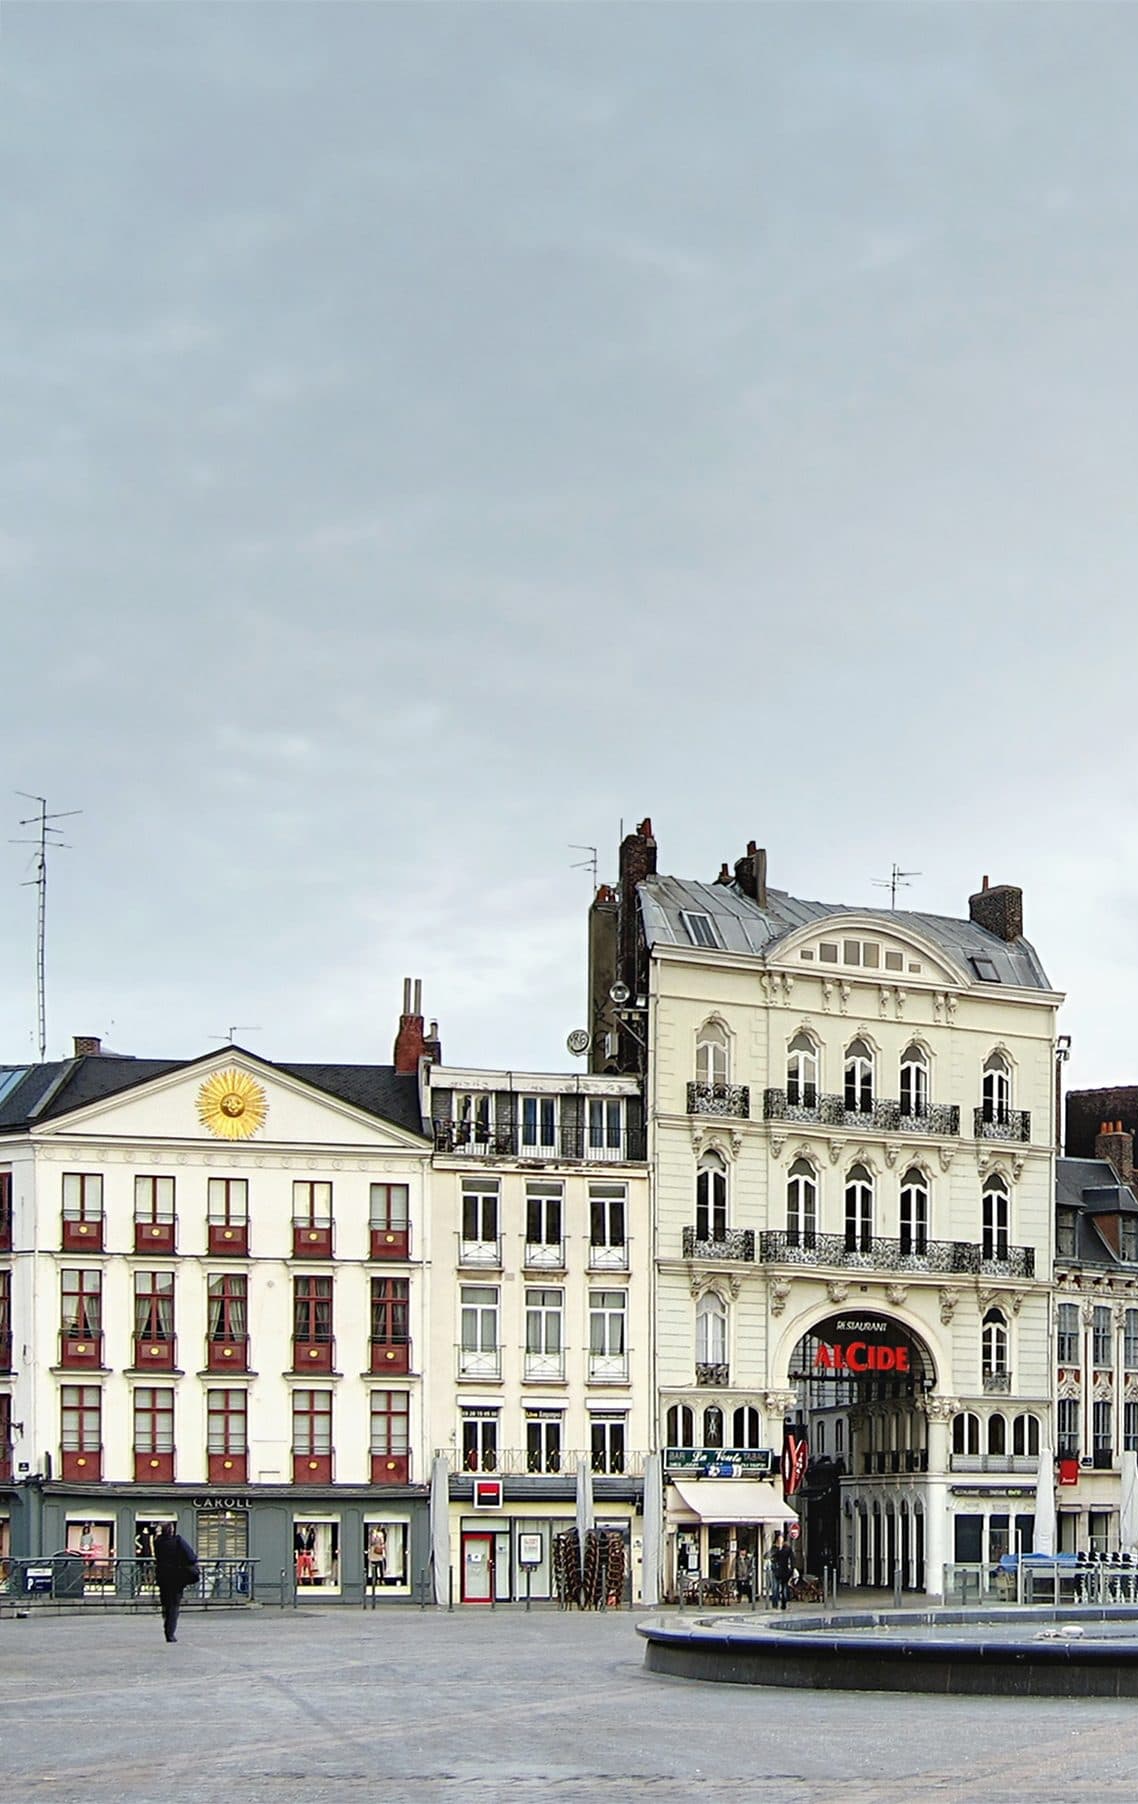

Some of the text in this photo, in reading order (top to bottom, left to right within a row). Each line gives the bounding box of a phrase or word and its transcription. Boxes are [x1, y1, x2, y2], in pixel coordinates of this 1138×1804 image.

[836, 1321, 888, 1332] RESTAURANT
[815, 1341, 910, 1373] ALCIDE
[193, 1498, 253, 1508] CAROLL
